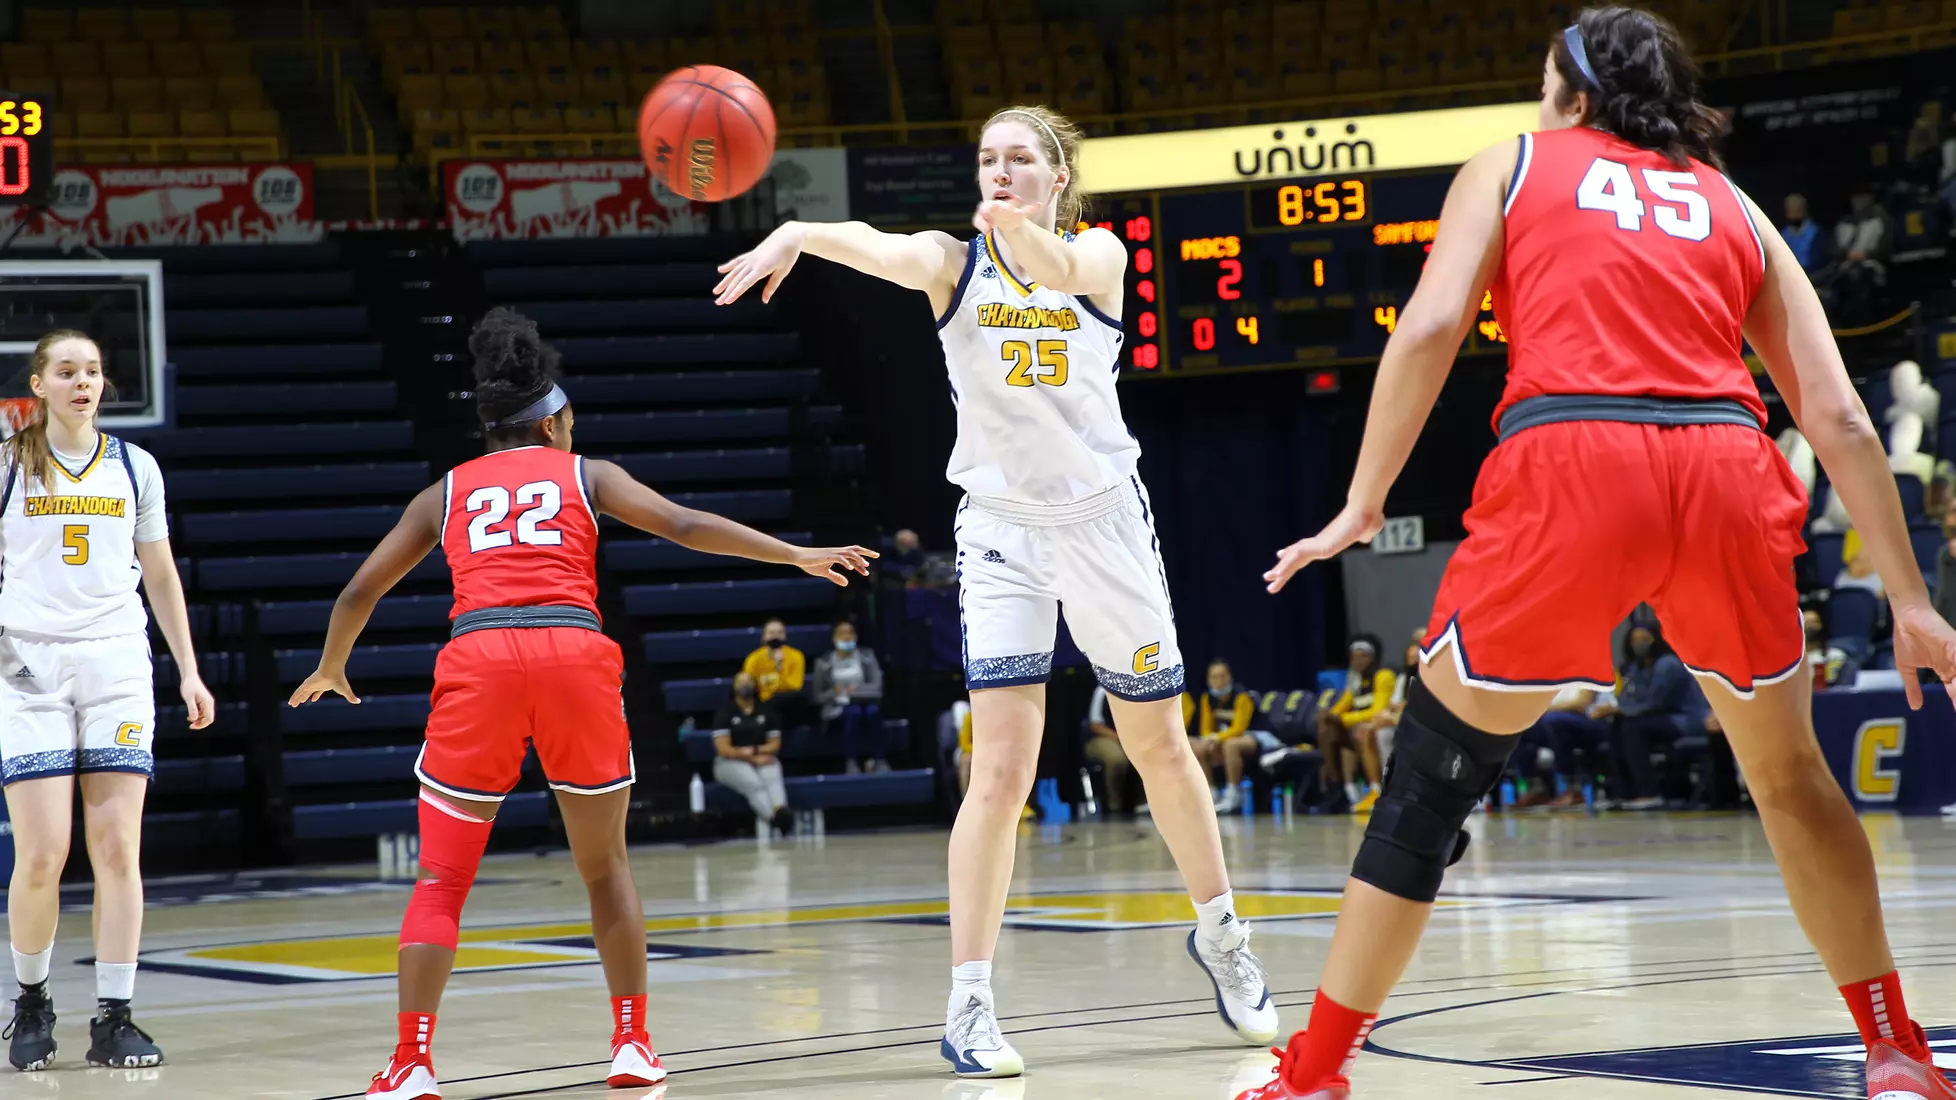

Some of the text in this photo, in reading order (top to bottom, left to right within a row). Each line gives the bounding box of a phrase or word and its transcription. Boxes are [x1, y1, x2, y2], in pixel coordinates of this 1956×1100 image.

[1277, 180, 1366, 227] 8:53
[1576, 157, 1712, 243] 45
[1180, 235, 1241, 262] MOCS
[1217, 259, 1243, 301] 2
[1312, 258, 1325, 287] 1
[1192, 317, 1216, 351] 0
[1236, 316, 1260, 346] 4
[1001, 340, 1069, 387] 25
[24, 496, 126, 518] CHATTANOOGA
[465, 480, 563, 554] 22
[62, 524, 90, 566] 5
[1132, 641, 1160, 676] C
[115, 721, 144, 748] C
[1851, 717, 1907, 802] C
